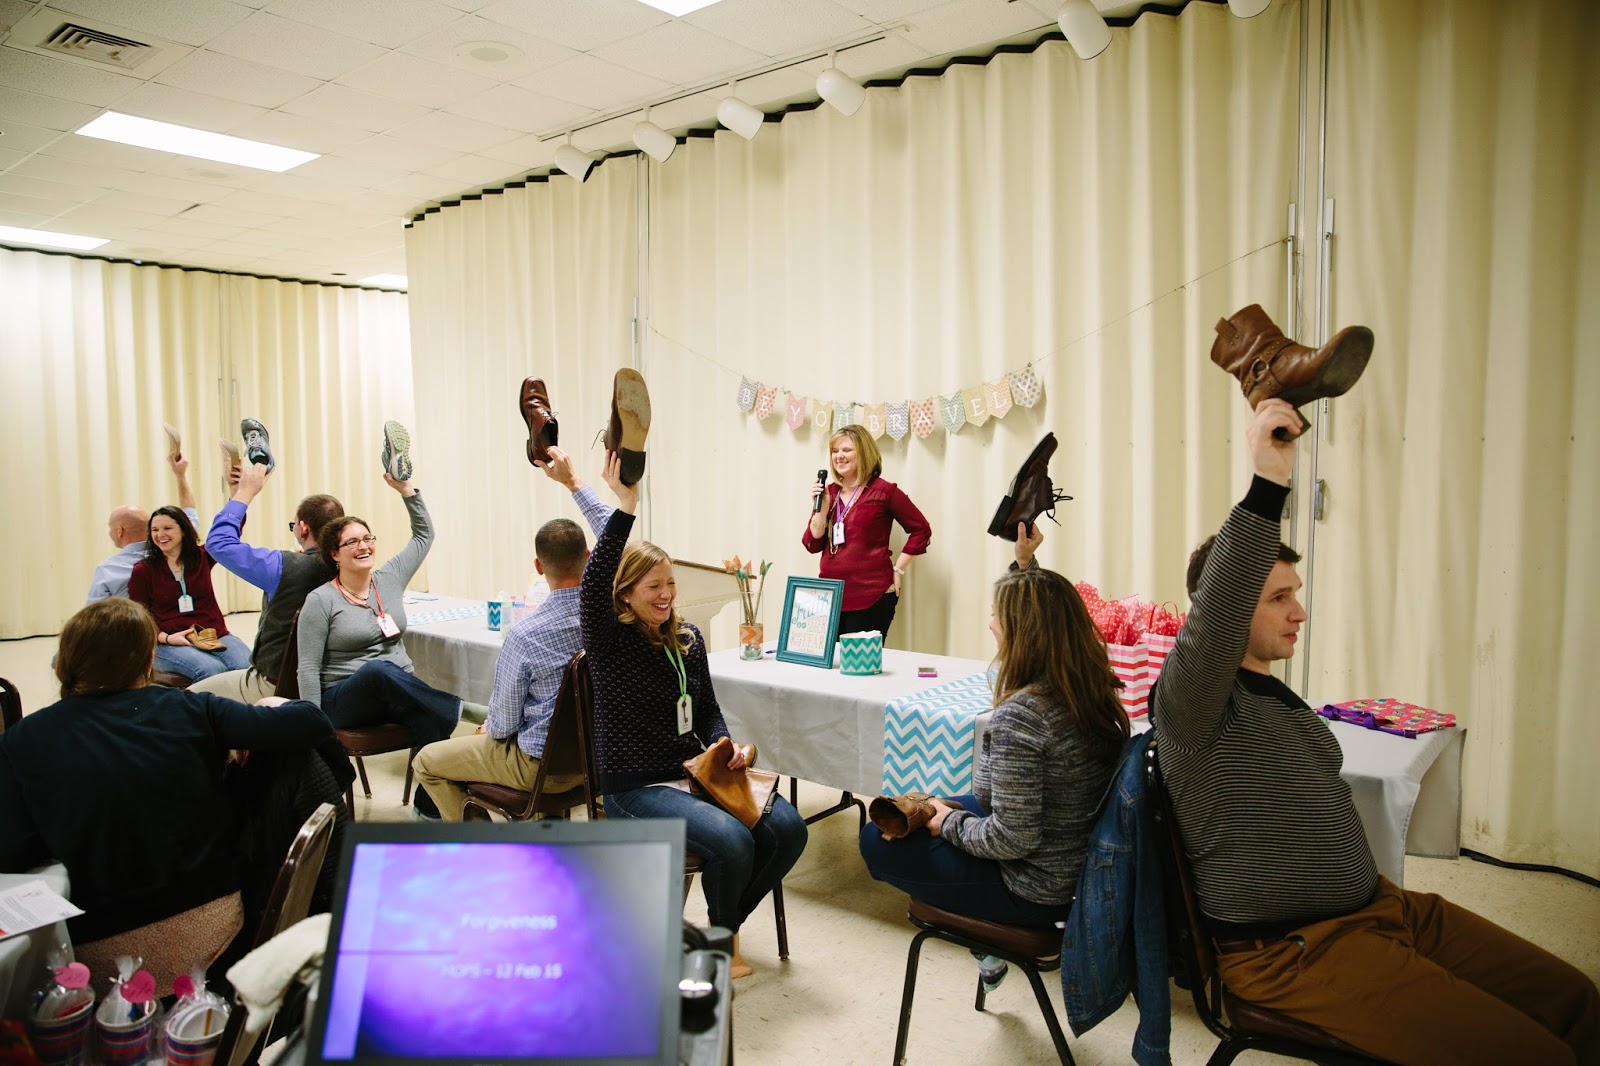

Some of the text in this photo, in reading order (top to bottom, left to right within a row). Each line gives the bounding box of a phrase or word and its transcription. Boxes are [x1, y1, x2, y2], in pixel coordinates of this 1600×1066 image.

[741, 377, 1032, 432] BE YOU BRAVELY
[460, 912, 558, 932] Forgiveness
[496, 962, 514, 979] 12
[514, 962, 543, 979] Feb
